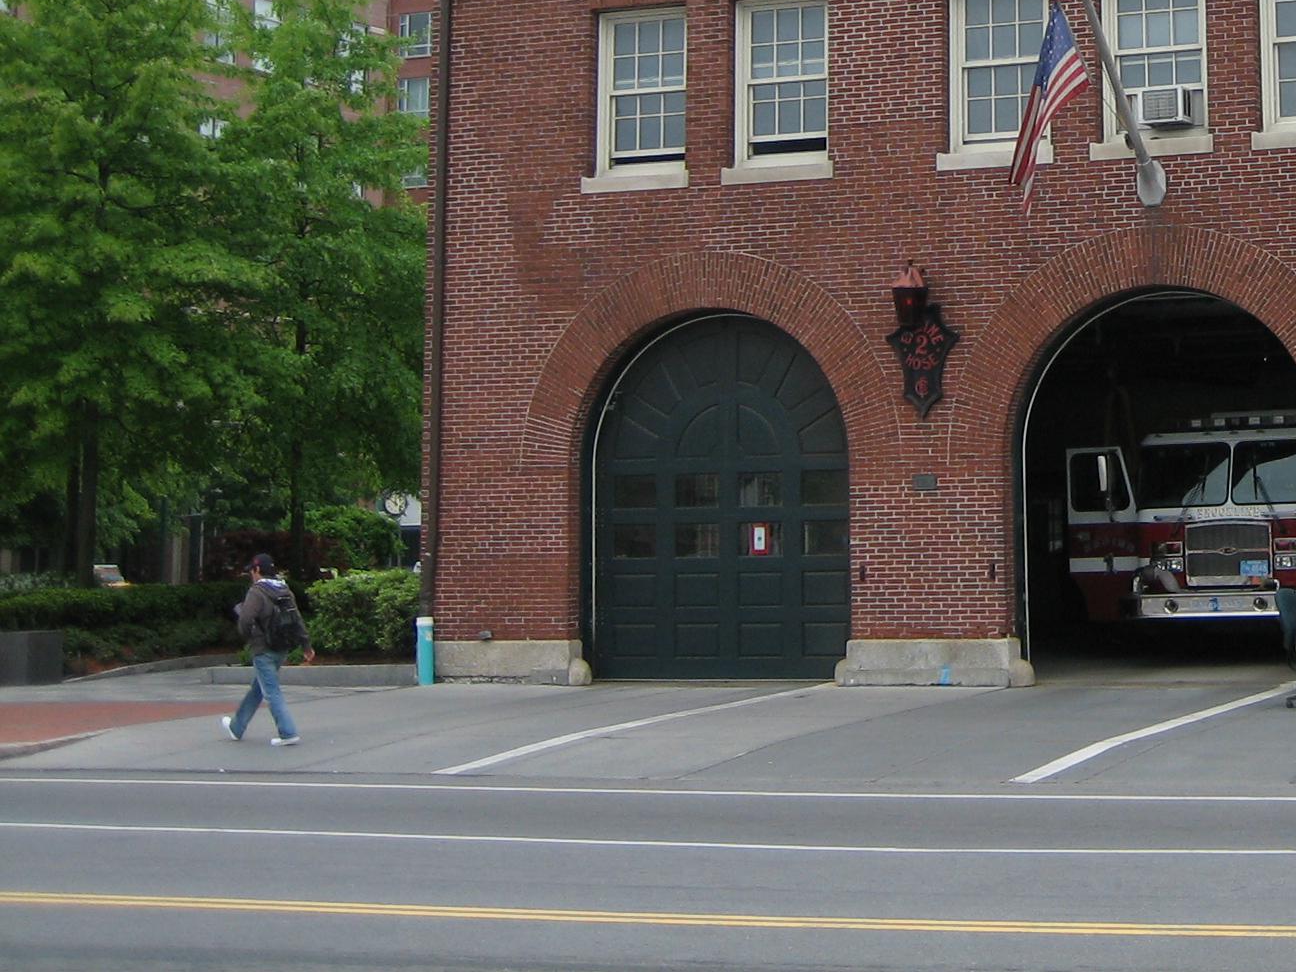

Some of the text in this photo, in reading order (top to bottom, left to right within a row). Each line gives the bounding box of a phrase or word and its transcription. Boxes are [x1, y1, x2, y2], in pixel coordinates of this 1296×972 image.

[901, 323, 944, 346] EINE
[915, 335, 929, 355] 2
[905, 353, 940, 370] HOSE
